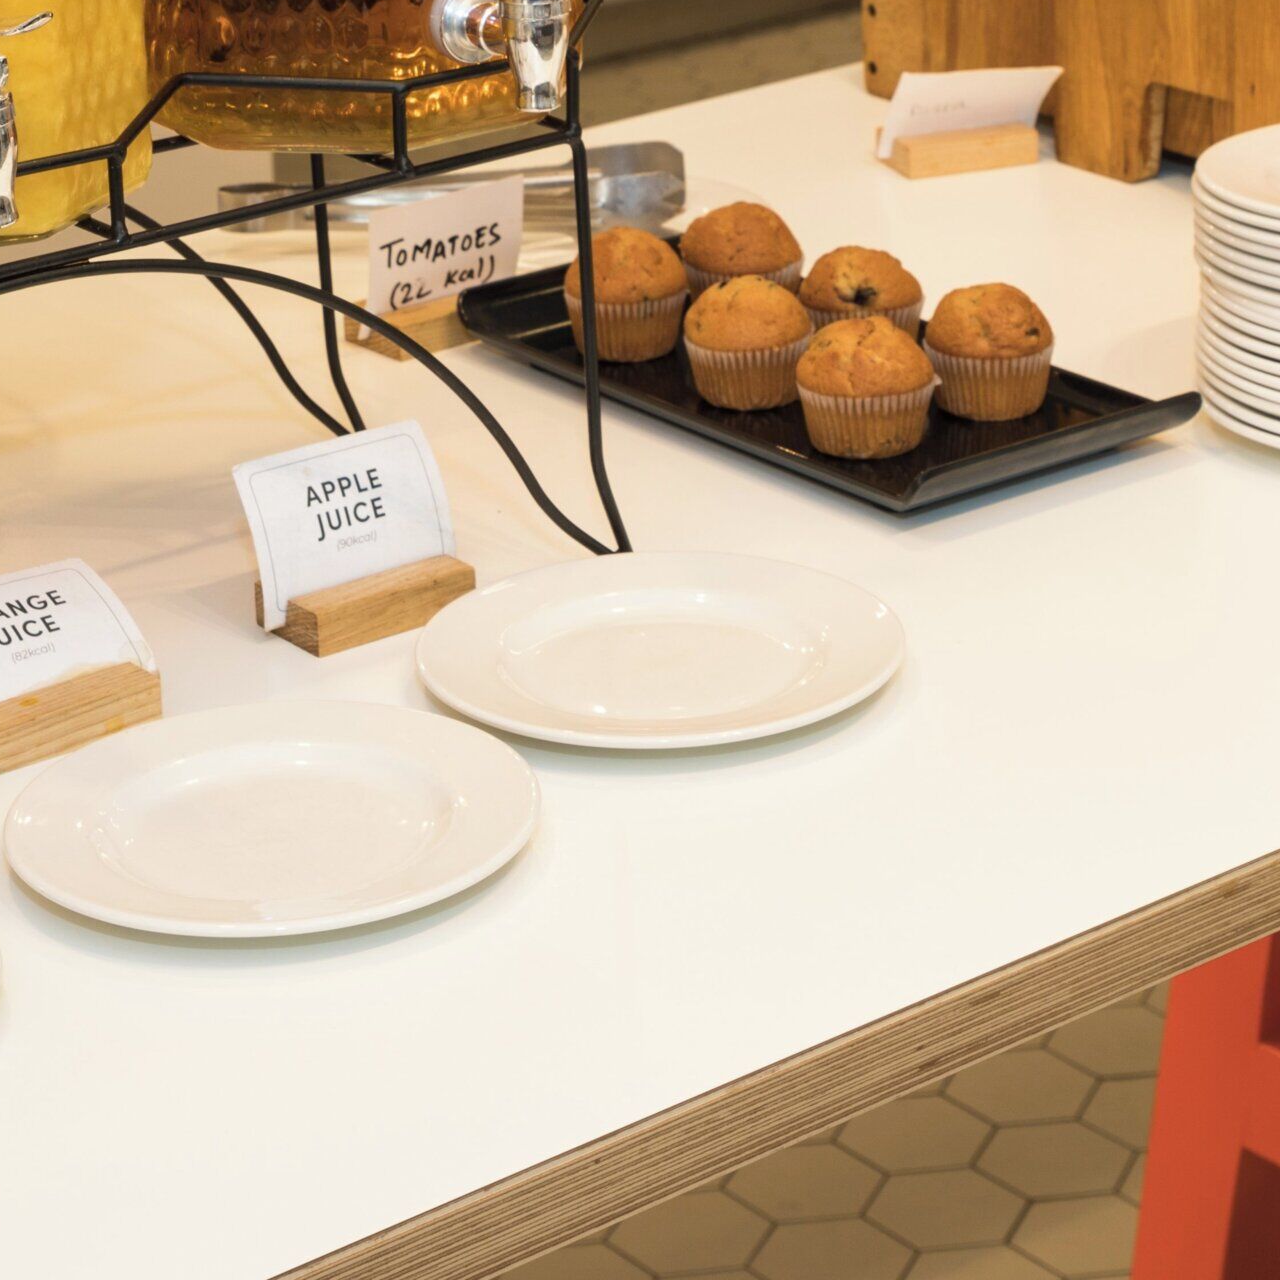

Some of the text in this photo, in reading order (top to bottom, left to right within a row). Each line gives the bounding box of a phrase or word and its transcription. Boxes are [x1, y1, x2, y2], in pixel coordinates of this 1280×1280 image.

[379, 223, 501, 268] TOMATOES
[305, 469, 382, 507] APPLE
[316, 497, 386, 541] JUICE
